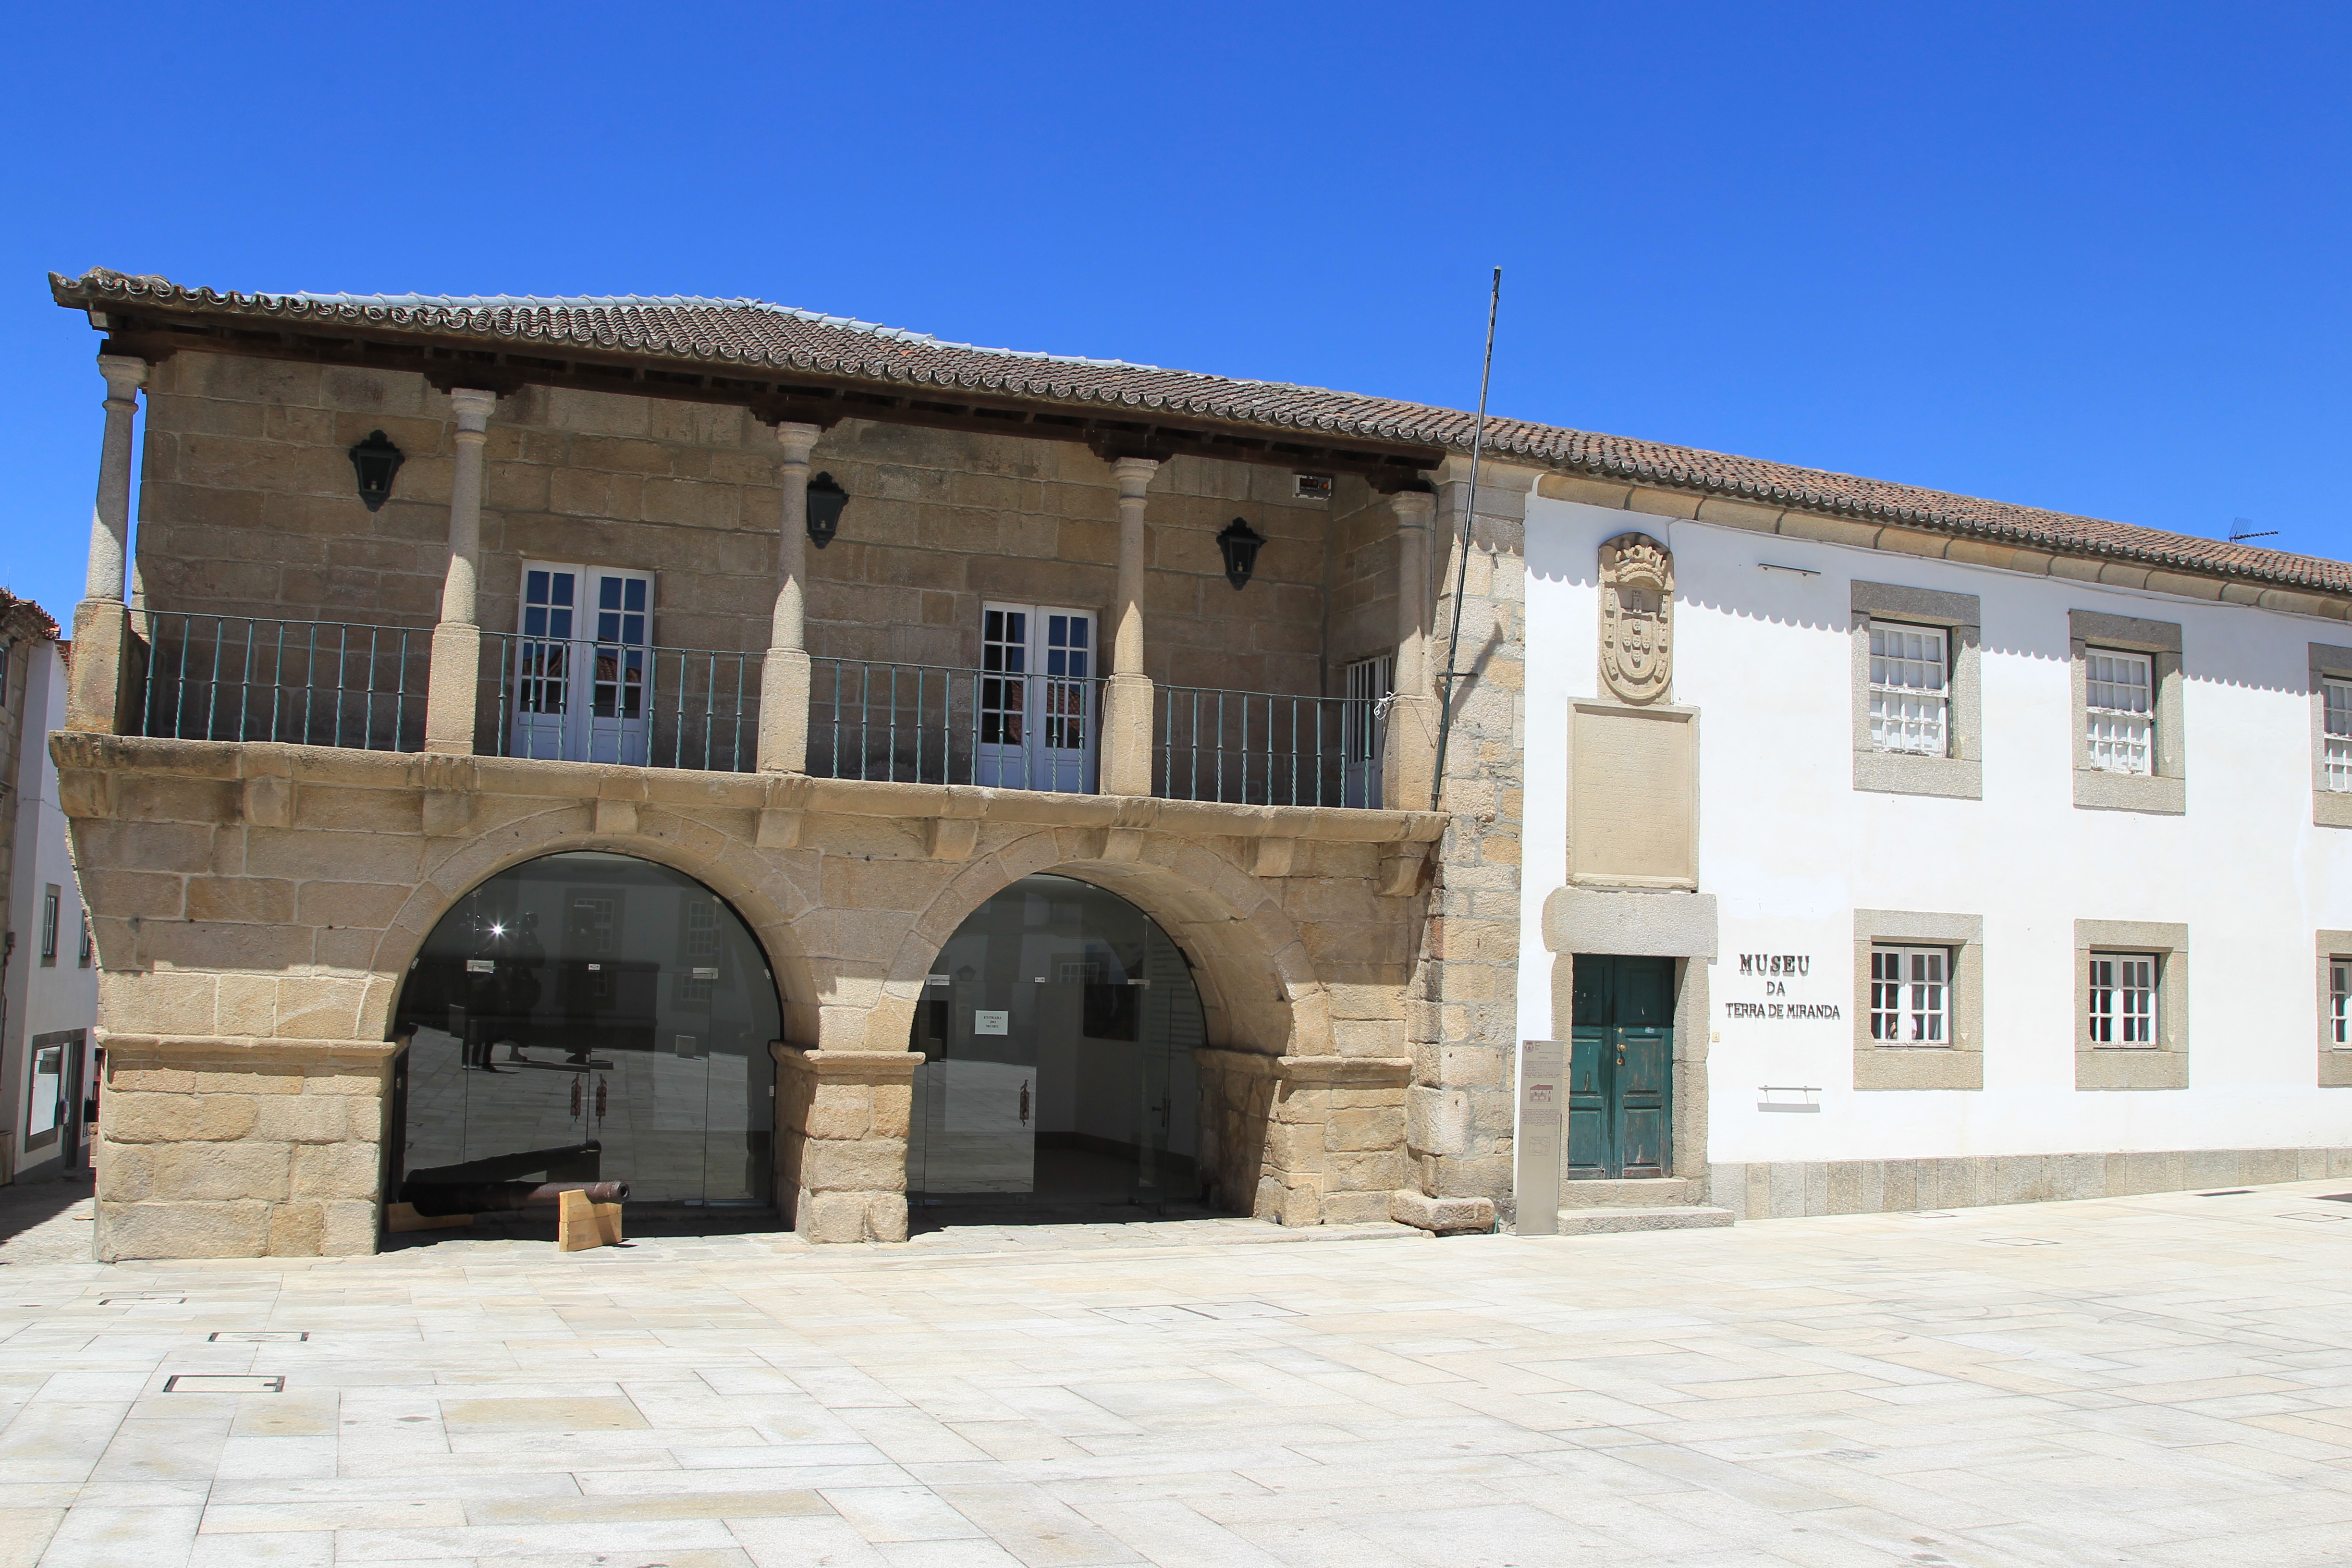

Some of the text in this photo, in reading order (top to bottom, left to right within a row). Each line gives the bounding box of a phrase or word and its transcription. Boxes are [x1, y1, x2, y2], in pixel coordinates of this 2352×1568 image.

[1739, 954, 1810, 974] MUSEU
[1766, 981, 1786, 995] DA
[1725, 1002, 1841, 1018] TERRA DE MIRANDA
